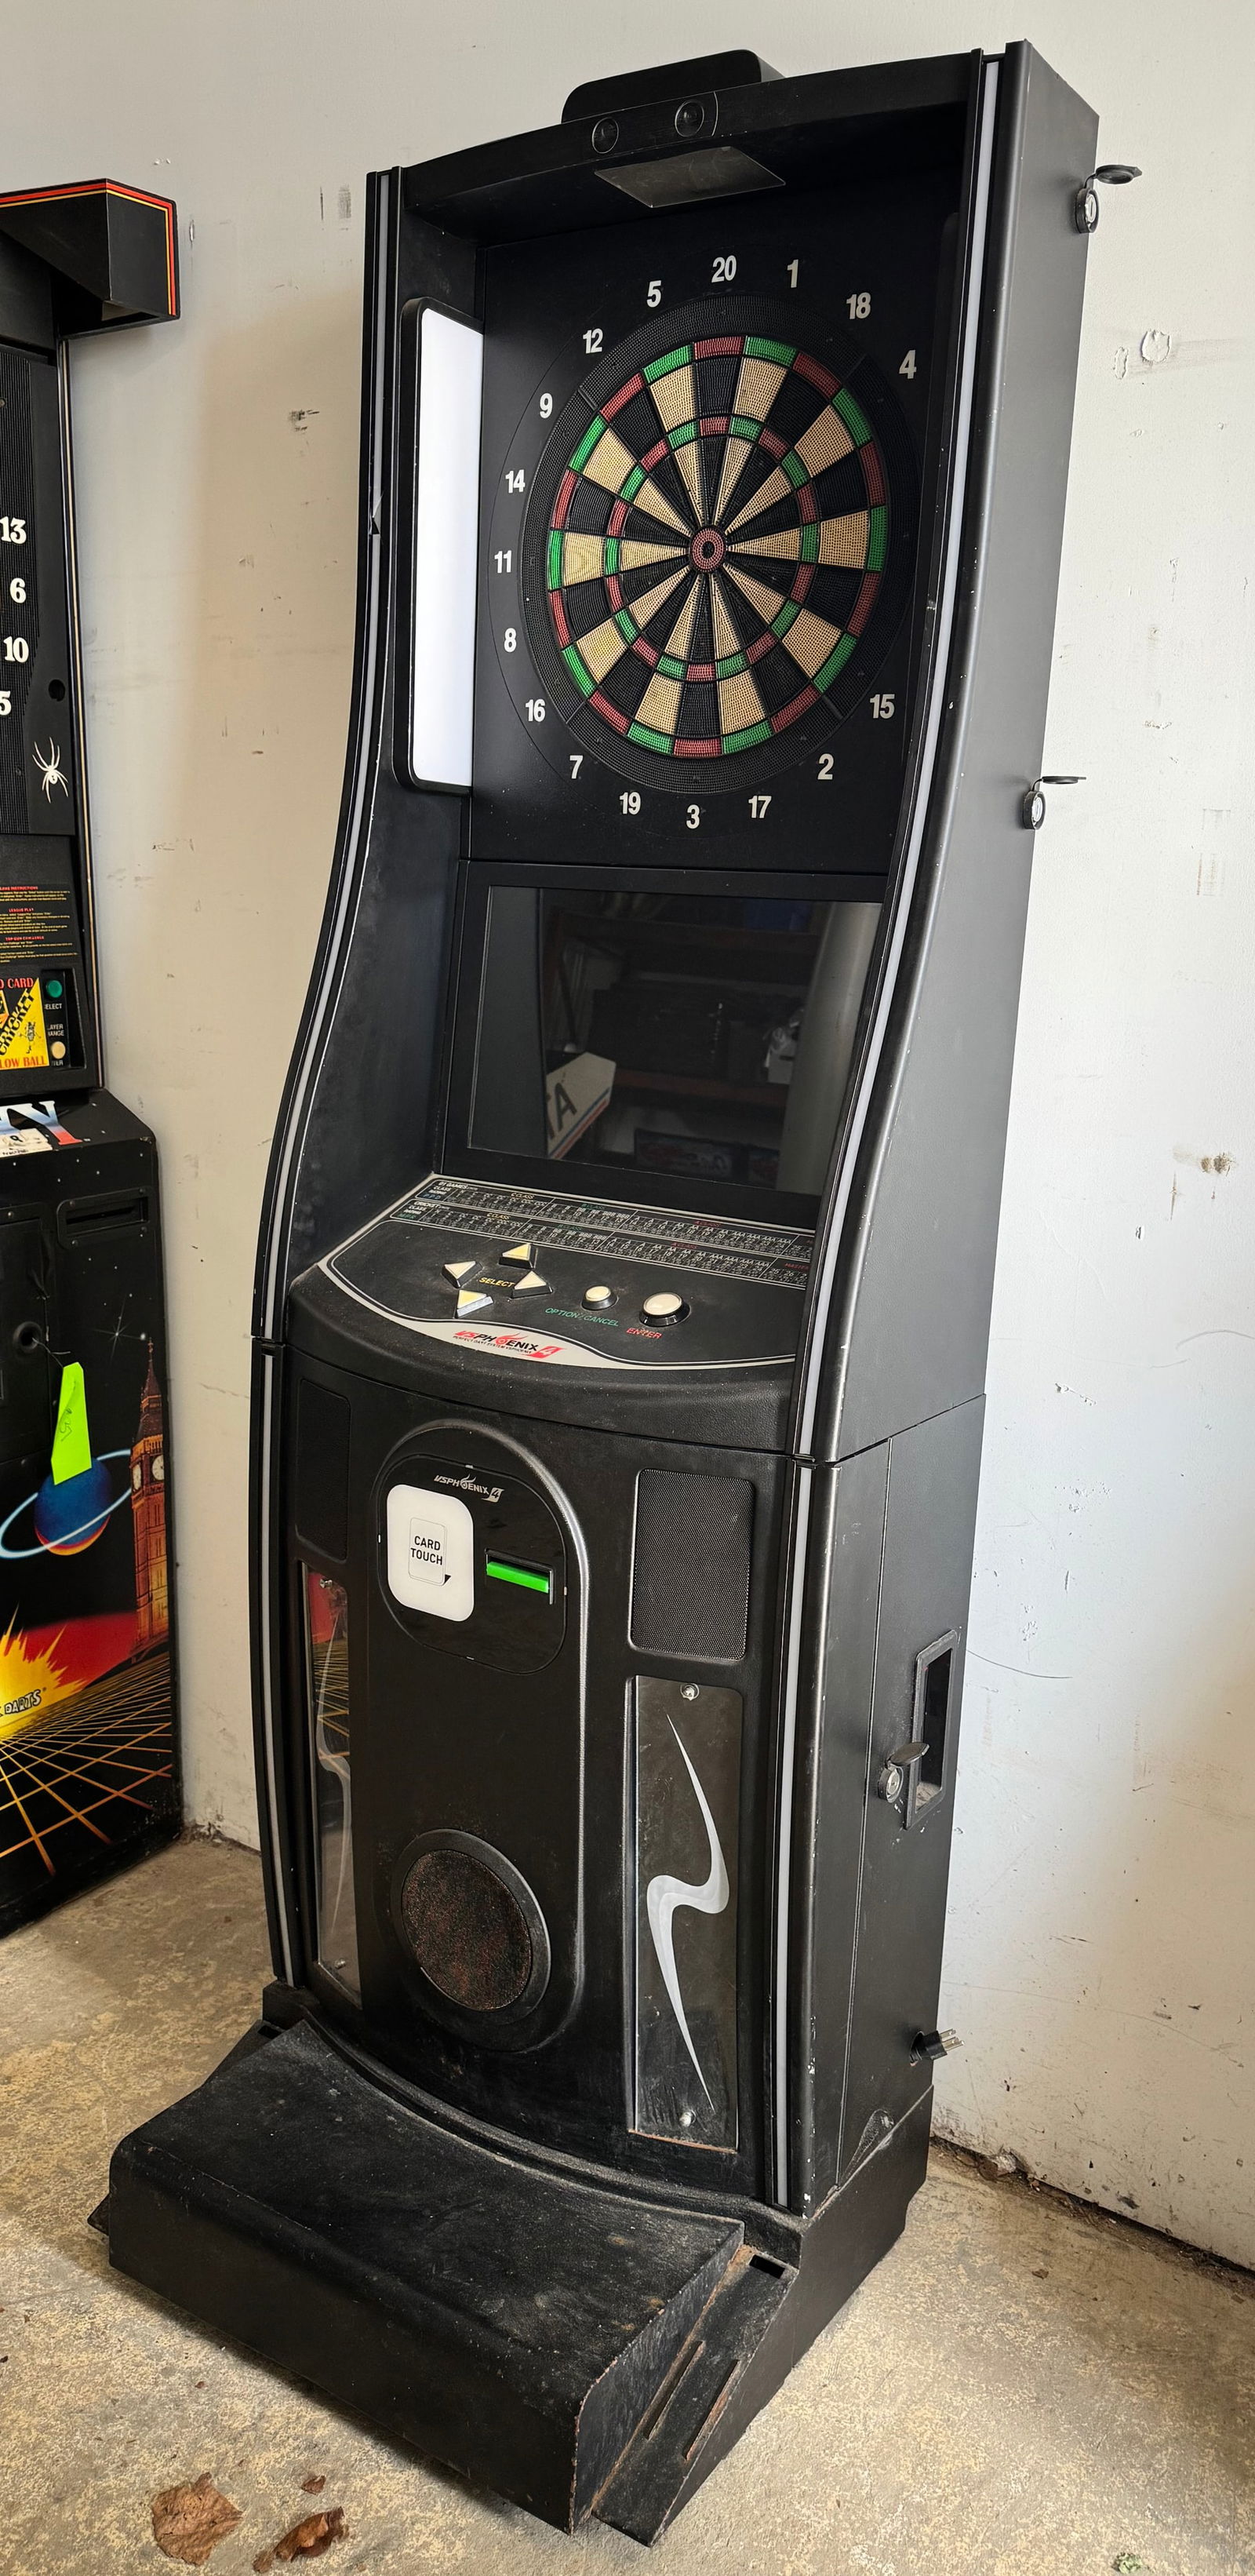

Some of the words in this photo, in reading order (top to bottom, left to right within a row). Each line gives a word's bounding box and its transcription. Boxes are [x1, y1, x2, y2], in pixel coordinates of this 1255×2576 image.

[711, 255, 737, 282] 20
[788, 259, 799, 289] 1
[646, 280, 662, 308] 5
[846, 292, 871, 320] 18
[582, 328, 603, 354] 12
[899, 349, 917, 380] 4
[539, 393, 553, 418] 9
[505, 470, 526, 493] 14
[0, 516, 27, 545] 13
[494, 550, 512, 573] 11
[9, 578, 27, 603] 6
[4, 636, 29, 663] 10
[503, 628, 517, 652] 8
[525, 699, 546, 722] 16
[870, 694, 896, 719] 15
[569, 755, 584, 779] 7
[817, 754, 834, 780] 2
[619, 792, 642, 815] 19
[748, 795, 773, 819] 17
[686, 804, 700, 829] 3
[7, 978, 34, 989] CARD
[24, 1055, 46, 1066] BALL
[478, 1277, 515, 1288] SELECT
[626, 1328, 663, 1339] ENTER
[410, 1547, 443, 1565] TOUCH
[414, 1536, 441, 1551] CARD
[4, 1689, 42, 1714] DARTS
